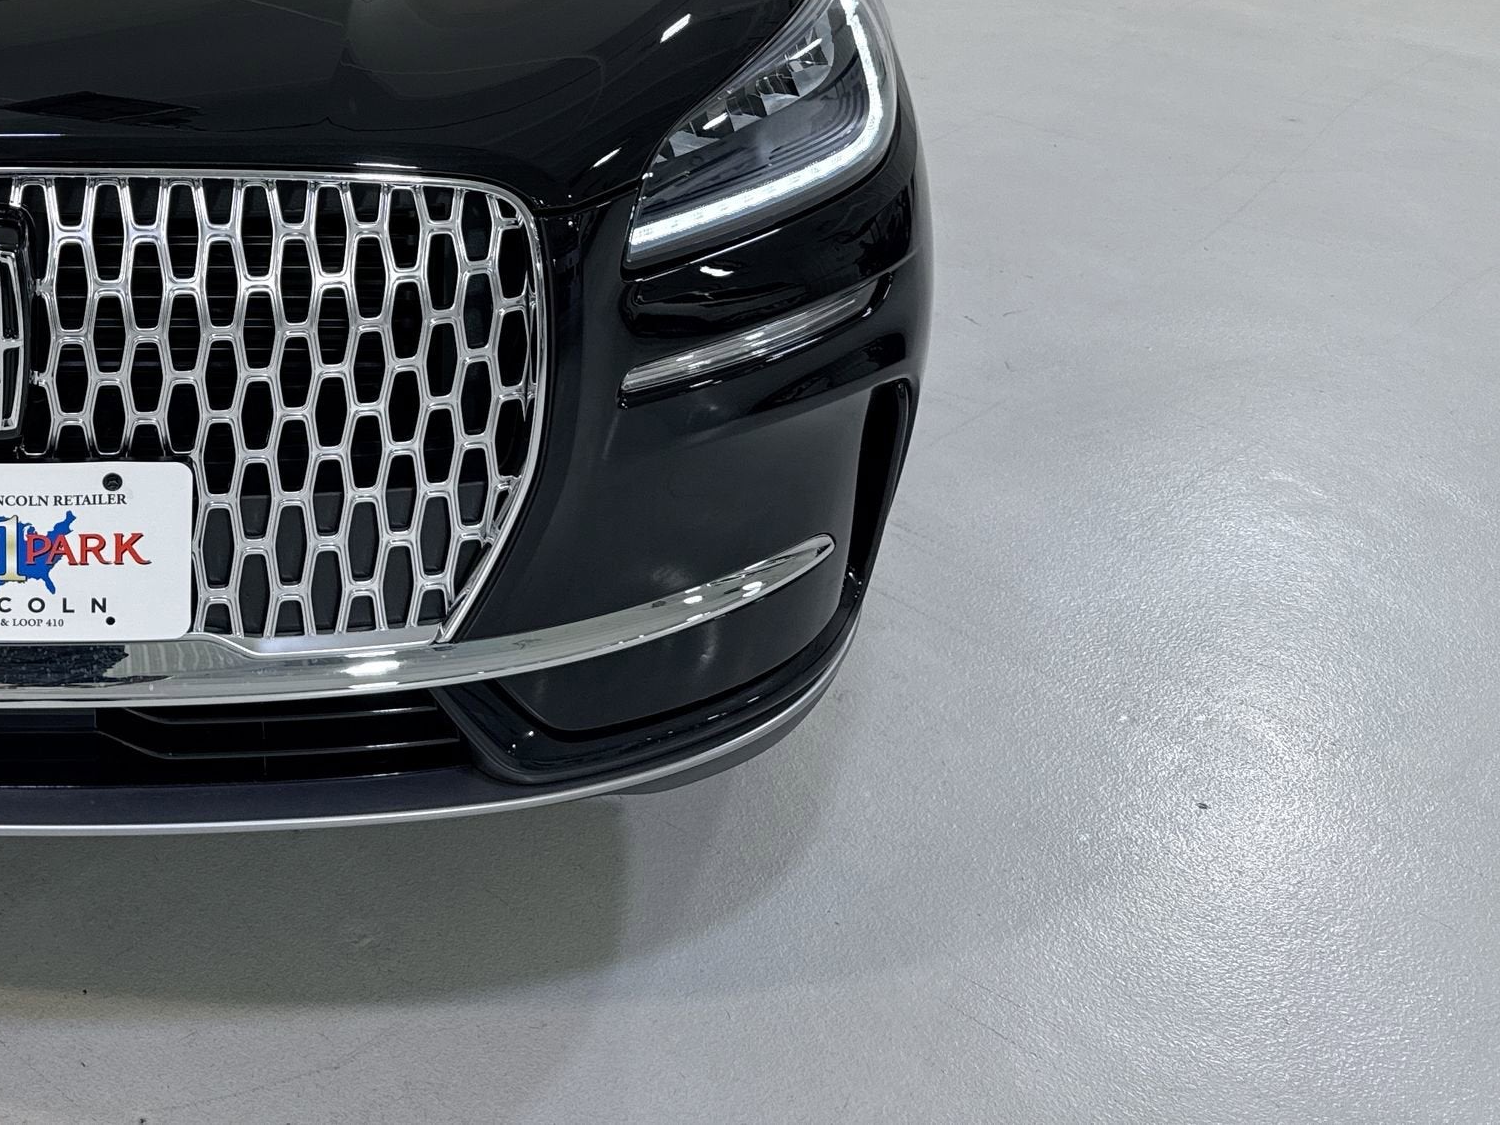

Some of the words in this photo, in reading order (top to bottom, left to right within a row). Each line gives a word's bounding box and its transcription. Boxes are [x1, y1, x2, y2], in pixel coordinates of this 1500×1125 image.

[54, 494, 126, 506] RETAILER
[25, 533, 152, 566] PARK
[0, 618, 9, 627] &
[12, 618, 44, 627] LOOP
[46, 618, 64, 627] 410
